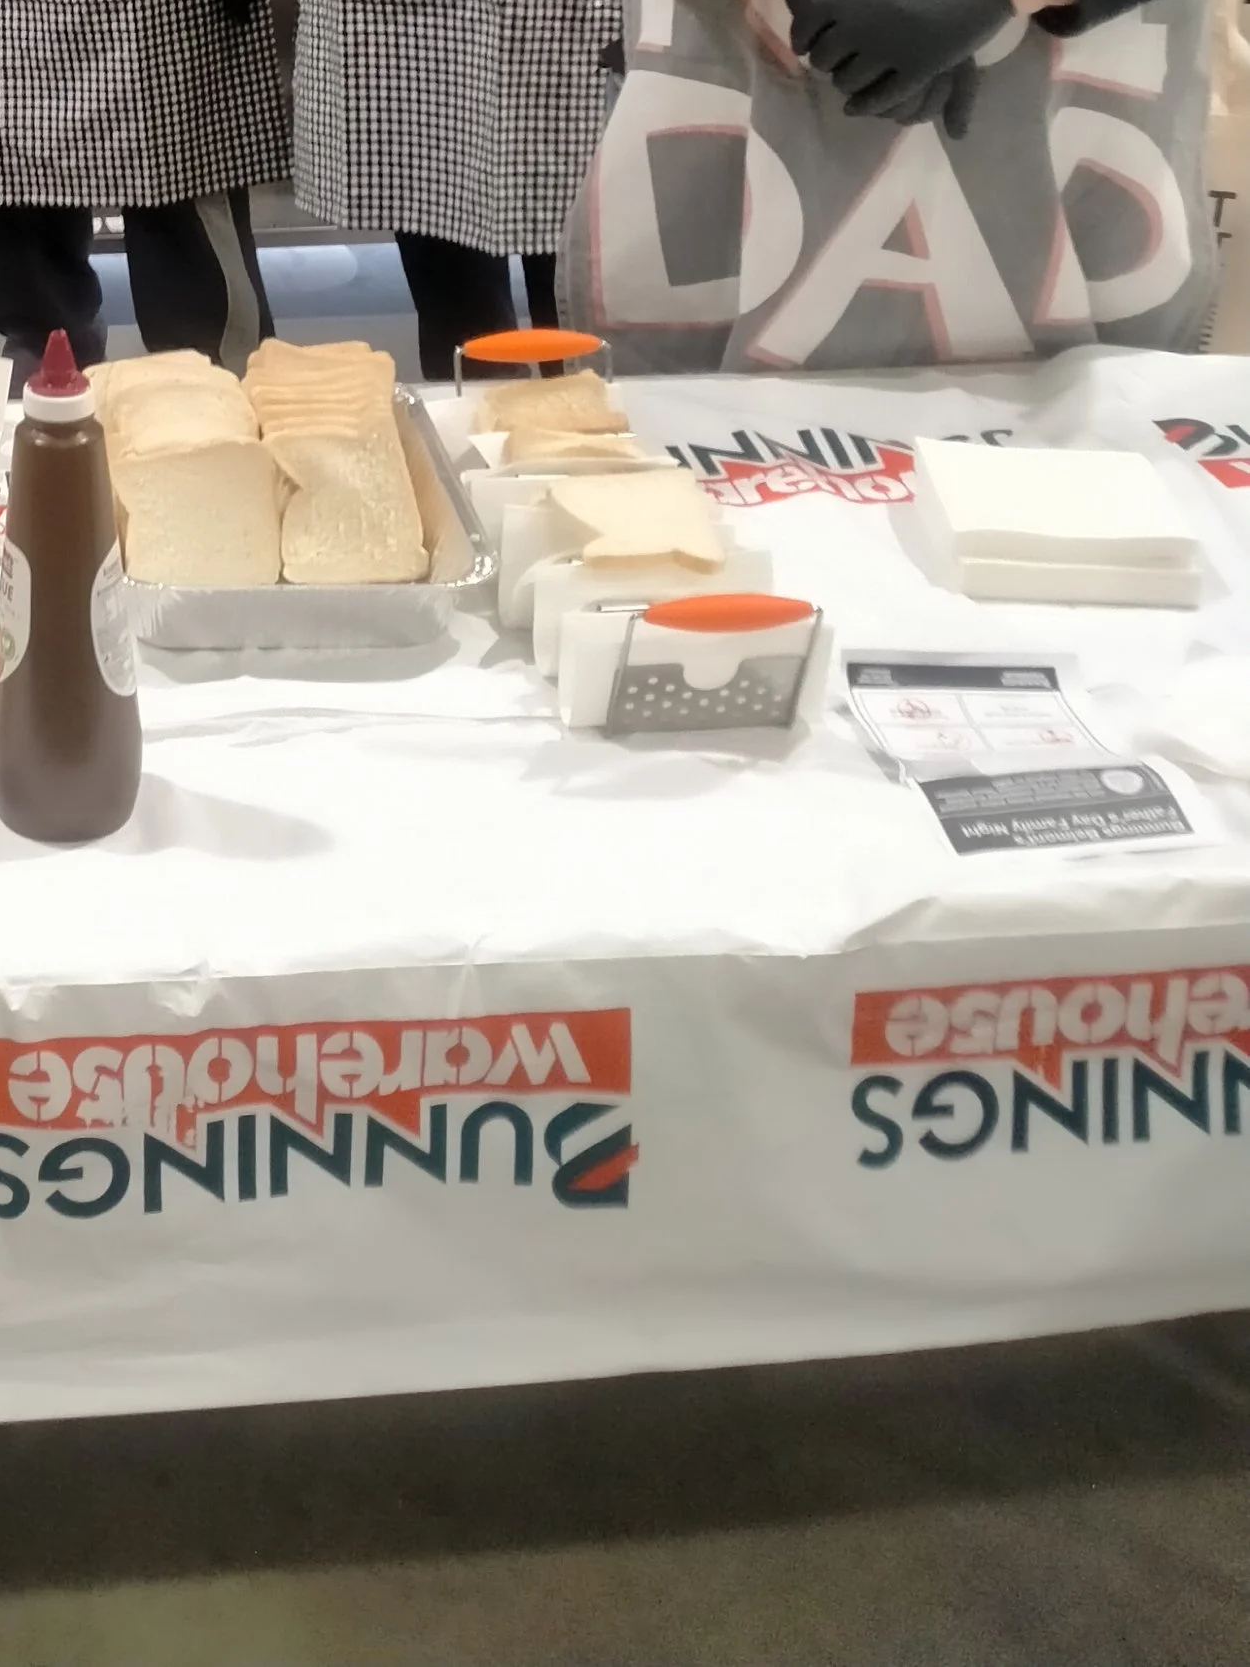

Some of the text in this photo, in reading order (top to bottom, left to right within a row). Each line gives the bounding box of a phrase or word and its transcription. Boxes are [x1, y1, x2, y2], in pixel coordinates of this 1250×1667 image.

[592, 69, 1192, 368] DAD
[960, 805, 1178, 839] Father's Day Family Night
[884, 970, 1250, 1064] ehouse
[7, 1020, 592, 1124] warehouse
[851, 1048, 1250, 1170] NINGS
